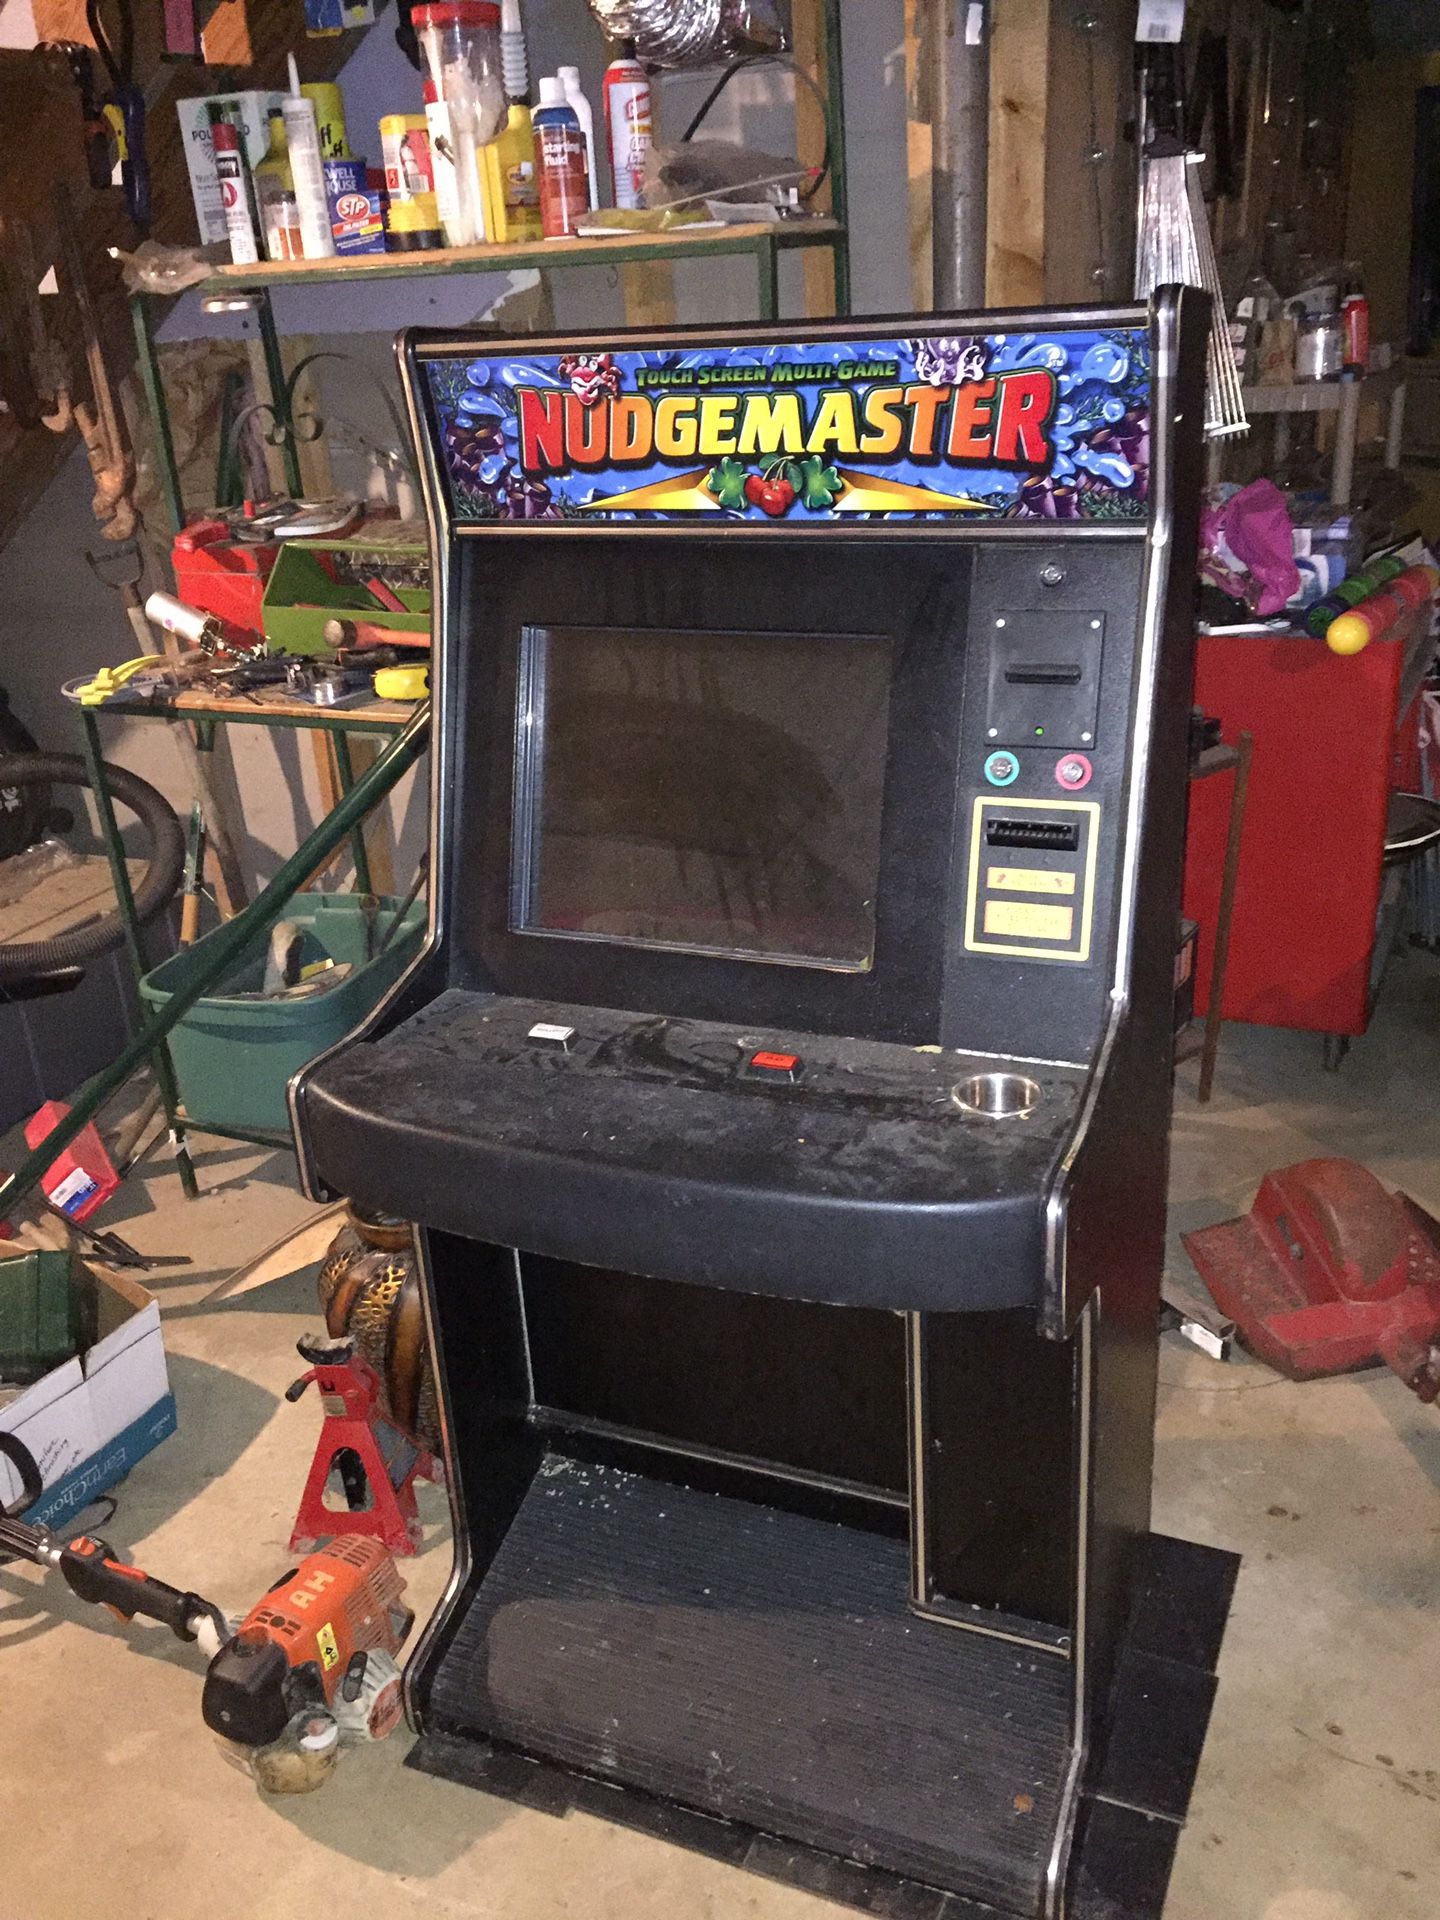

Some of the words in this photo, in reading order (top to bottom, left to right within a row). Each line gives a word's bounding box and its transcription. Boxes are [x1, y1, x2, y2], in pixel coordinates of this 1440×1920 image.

[543, 141, 581, 155] starting
[543, 154, 569, 167] fluid
[341, 196, 366, 216] STP
[636, 368, 694, 387] TOUCH
[697, 364, 767, 385] SCREEN
[770, 359, 897, 383] MULTI-GAME
[516, 370, 1051, 472] NUDGEMASTER
